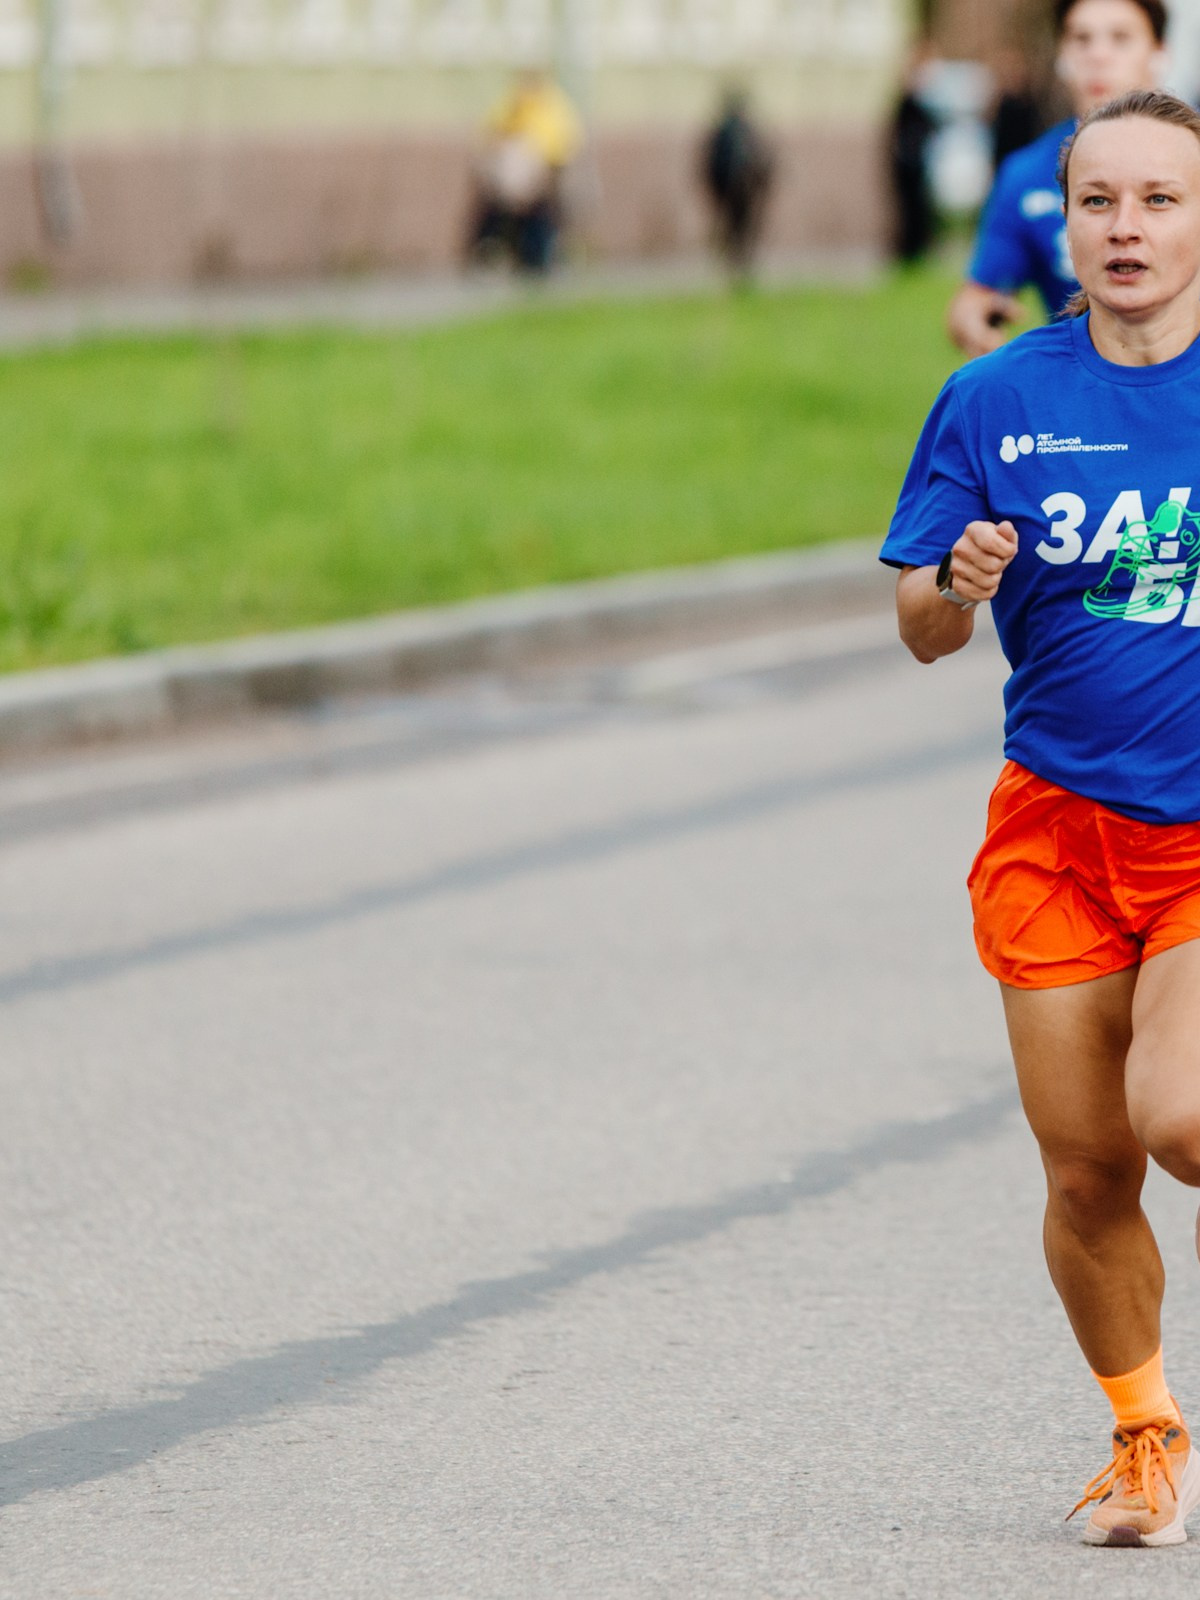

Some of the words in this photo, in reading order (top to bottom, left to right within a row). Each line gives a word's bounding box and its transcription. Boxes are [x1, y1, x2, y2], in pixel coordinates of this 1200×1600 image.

[1036, 433, 1054, 441] ЛЕТ
[1036, 437, 1082, 448] АТОМНОЙ
[1036, 444, 1129, 454] ПРОМЫШЛЕННОСТИ
[1035, 487, 1192, 565] ЗА!
